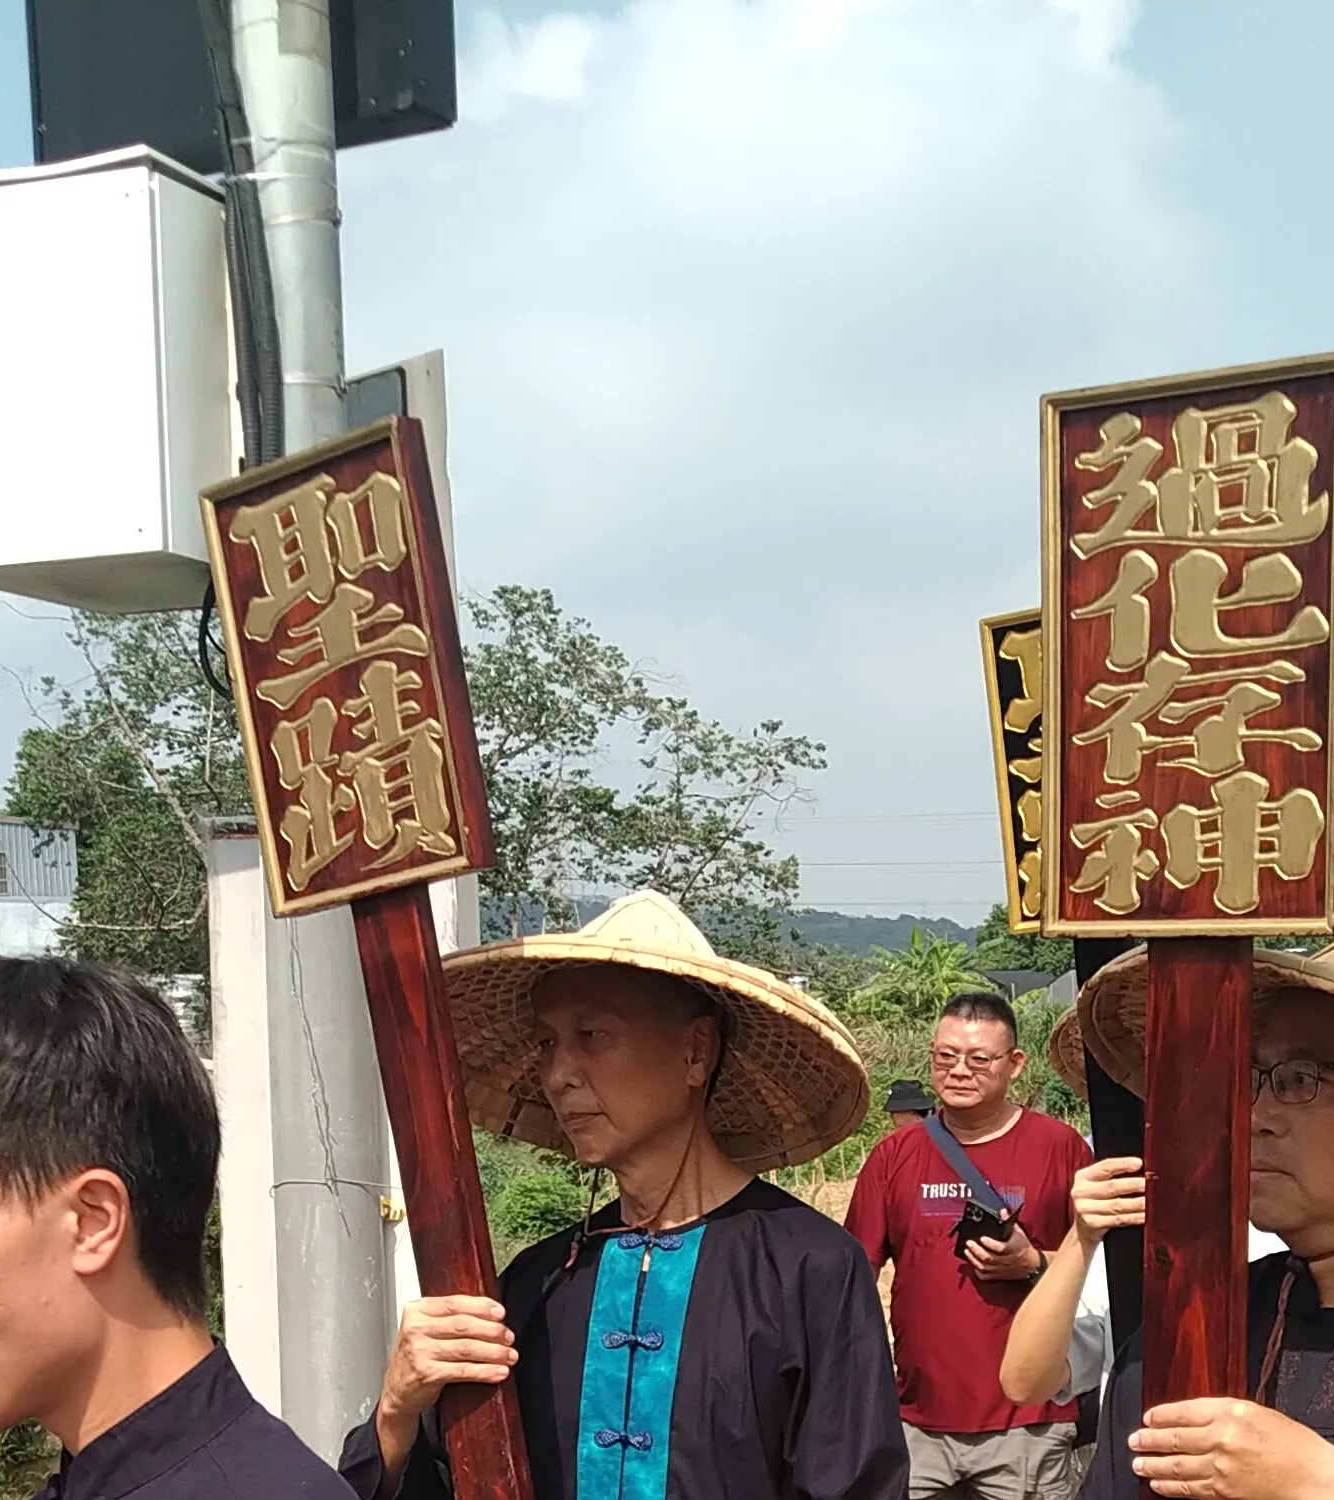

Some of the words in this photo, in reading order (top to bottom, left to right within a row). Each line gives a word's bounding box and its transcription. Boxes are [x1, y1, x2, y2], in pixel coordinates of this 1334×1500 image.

[229, 471, 457, 893] 聖蹟
[1069, 390, 1330, 915] 過化存神
